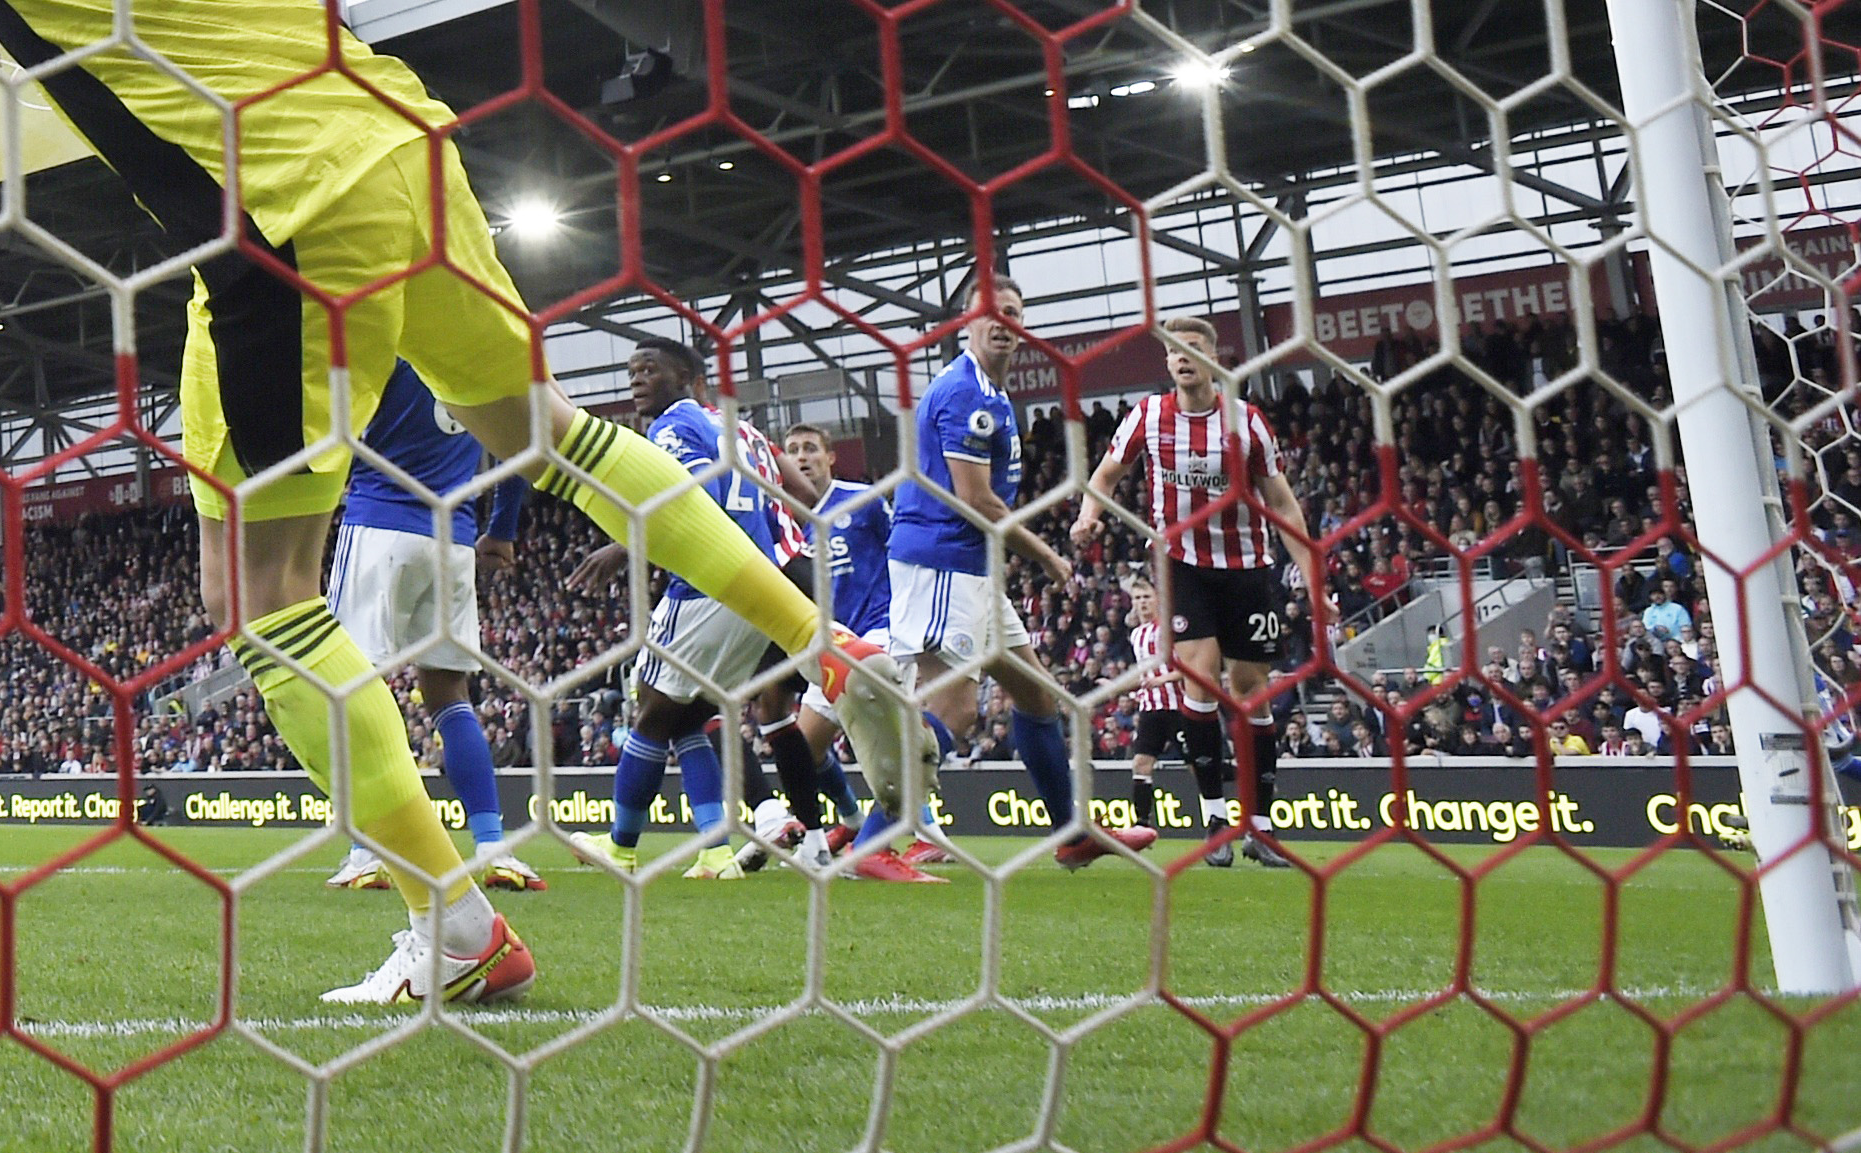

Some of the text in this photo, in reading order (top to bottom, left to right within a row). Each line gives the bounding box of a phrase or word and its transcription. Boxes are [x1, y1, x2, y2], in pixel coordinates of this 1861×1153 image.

[1005, 366, 1058, 393] CISM
[1248, 610, 1280, 642] 20
[11, 794, 64, 824] Report
[64, 794, 83, 818] it.
[185, 792, 274, 826] Challenge
[274, 792, 297, 820] it.
[1153, 788, 1193, 828] it.
[1332, 789, 1372, 829] it.
[1378, 791, 1540, 843] Change
[1547, 791, 1596, 833] it.
